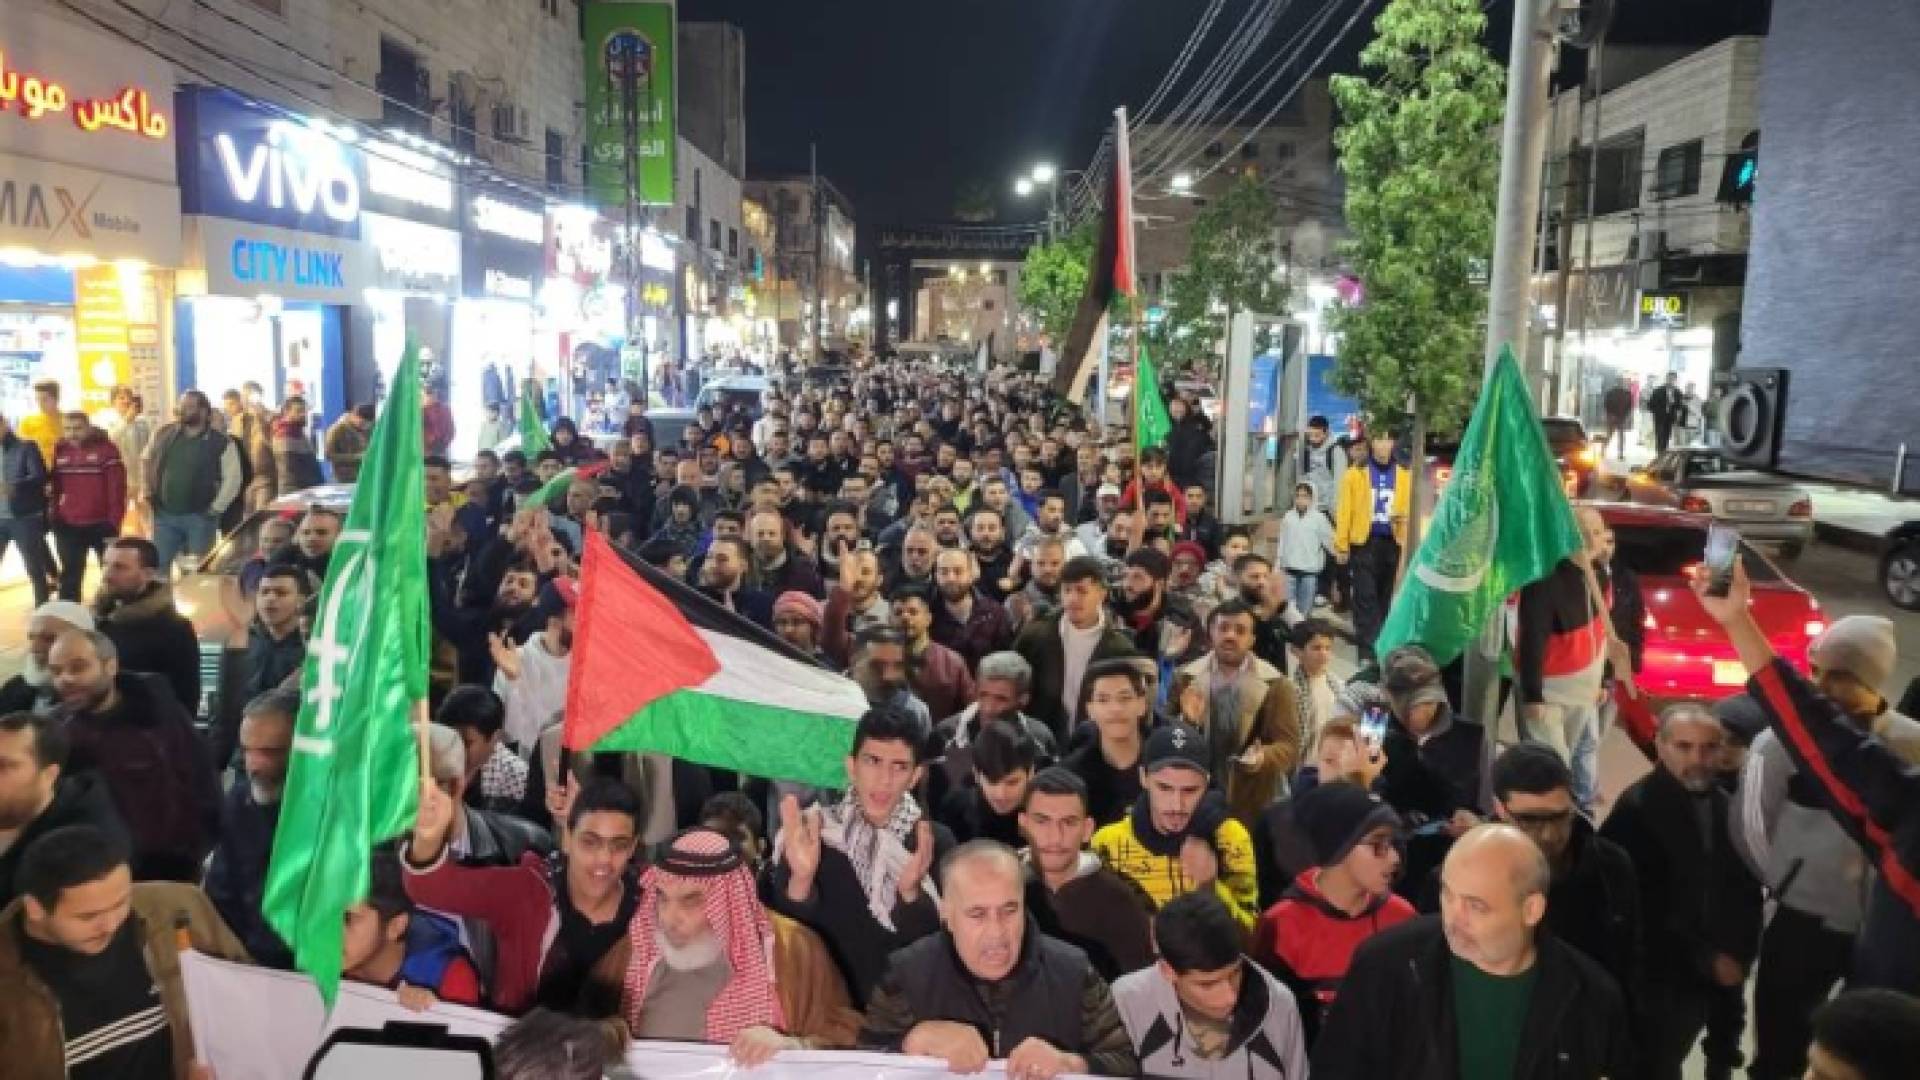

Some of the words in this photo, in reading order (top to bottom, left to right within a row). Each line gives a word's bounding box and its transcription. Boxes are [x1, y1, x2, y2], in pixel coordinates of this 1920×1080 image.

[75, 86, 168, 138] ماكس
[231, 238, 287, 283] CITY
[294, 248, 344, 287] LINK
